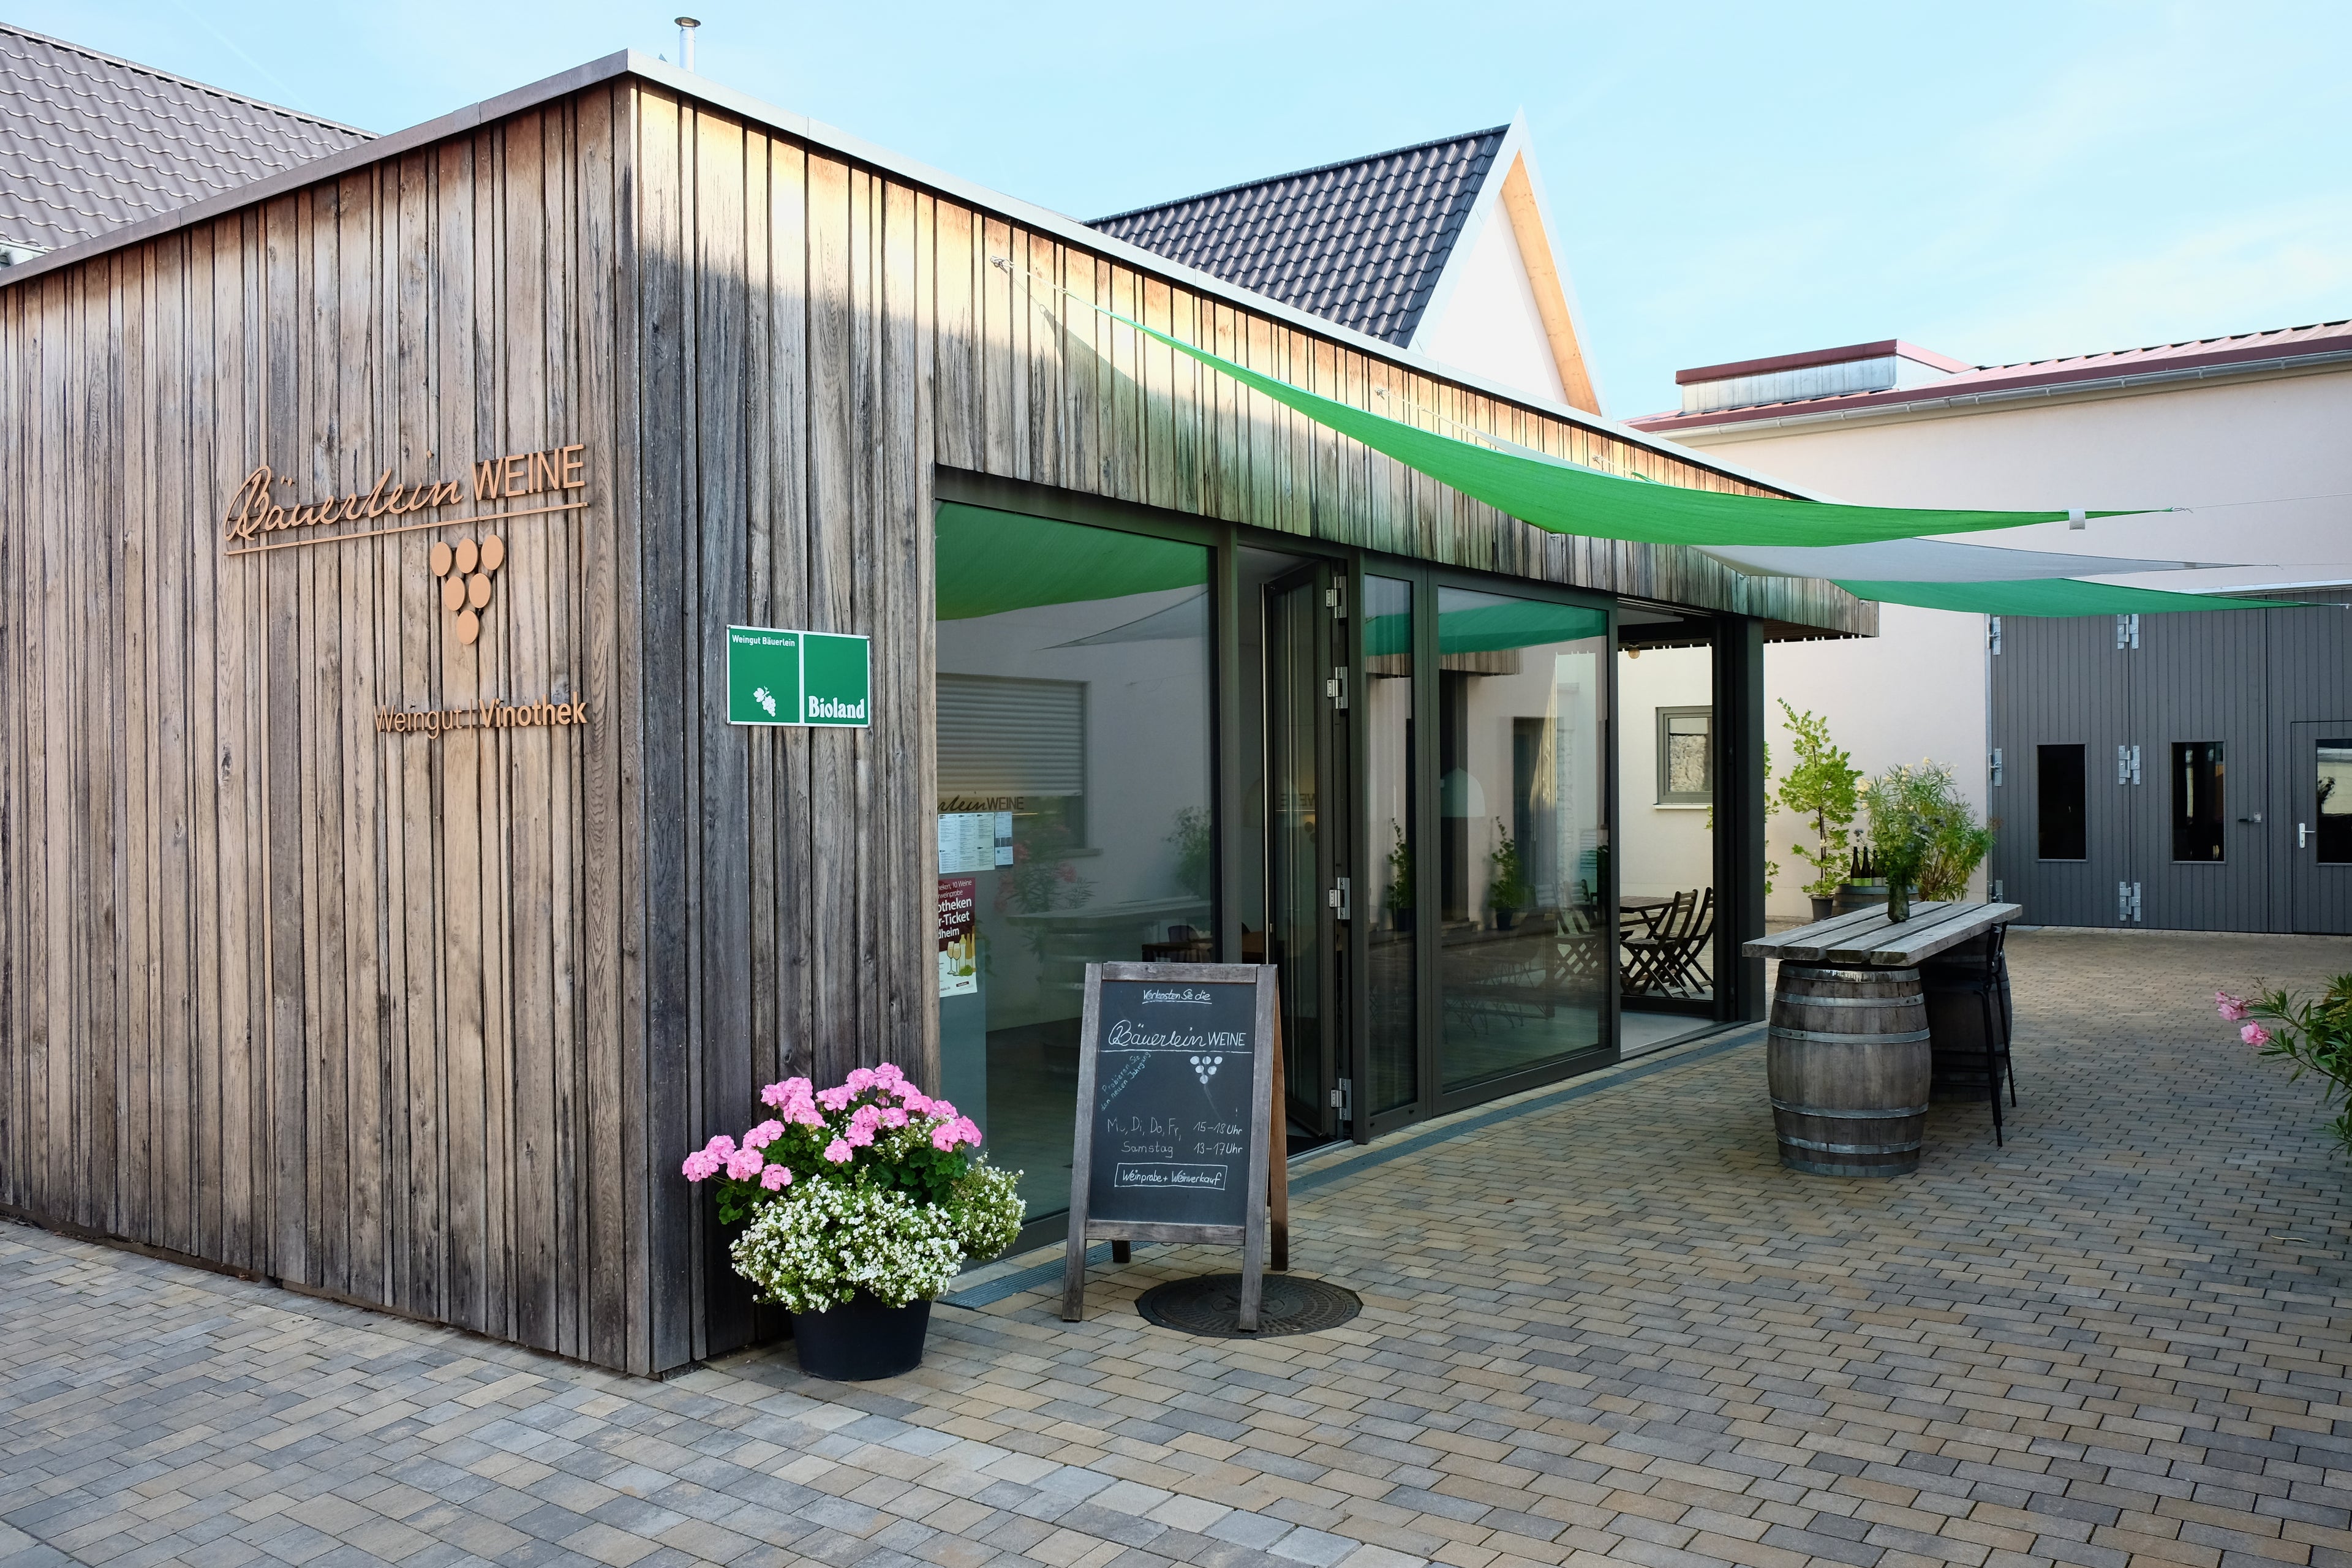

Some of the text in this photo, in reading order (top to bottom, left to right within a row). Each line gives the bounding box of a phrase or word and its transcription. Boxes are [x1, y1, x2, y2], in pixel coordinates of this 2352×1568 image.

[224, 444, 586, 541] Bäuerlein WEINE
[732, 635, 796, 647] Weingut Bäuerlein
[374, 704, 462, 739] Weingut
[479, 691, 587, 727] Vinothek
[808, 695, 865, 719] Bioland
[987, 796, 1024, 810] WEINE
[1144, 989, 1211, 1000] Verkosten Sie die
[1108, 1019, 1247, 1047] Bäuerlein WEINE
[1227, 1125, 1242, 1135] Uhr
[1121, 1141, 1173, 1158] Samstag
[1226, 1144, 1243, 1155] Uhr
[1171, 1170, 1222, 1185] Weinverkauf
